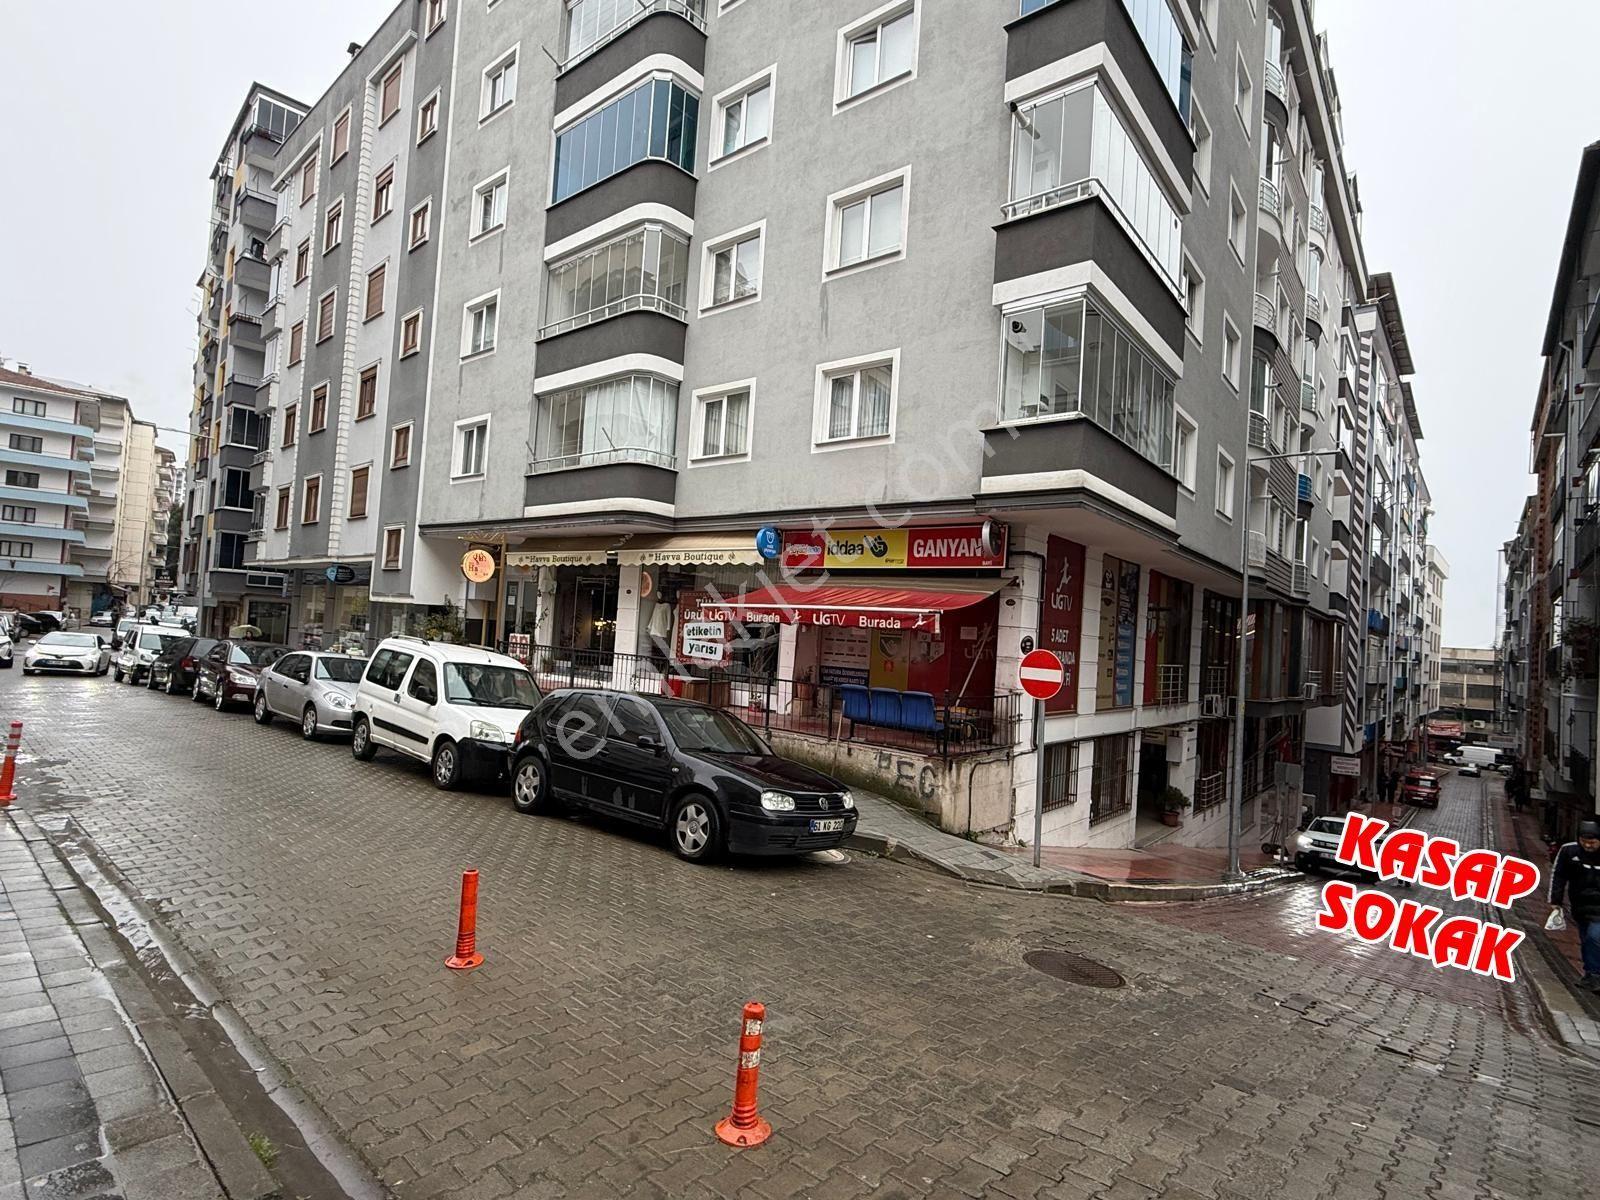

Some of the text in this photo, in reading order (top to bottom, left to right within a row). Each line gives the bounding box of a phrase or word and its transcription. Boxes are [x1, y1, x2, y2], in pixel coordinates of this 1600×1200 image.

[827, 540, 864, 555] iddaa
[913, 538, 982, 557] GANYAN
[552, 554, 583, 565] Boutique
[655, 553, 681, 561] Havva
[684, 552, 724, 563] Boutique
[746, 611, 780, 623] Burada
[859, 615, 901, 629] Burada
[686, 625, 722, 637] etiketin
[688, 642, 717, 655] yarısı
